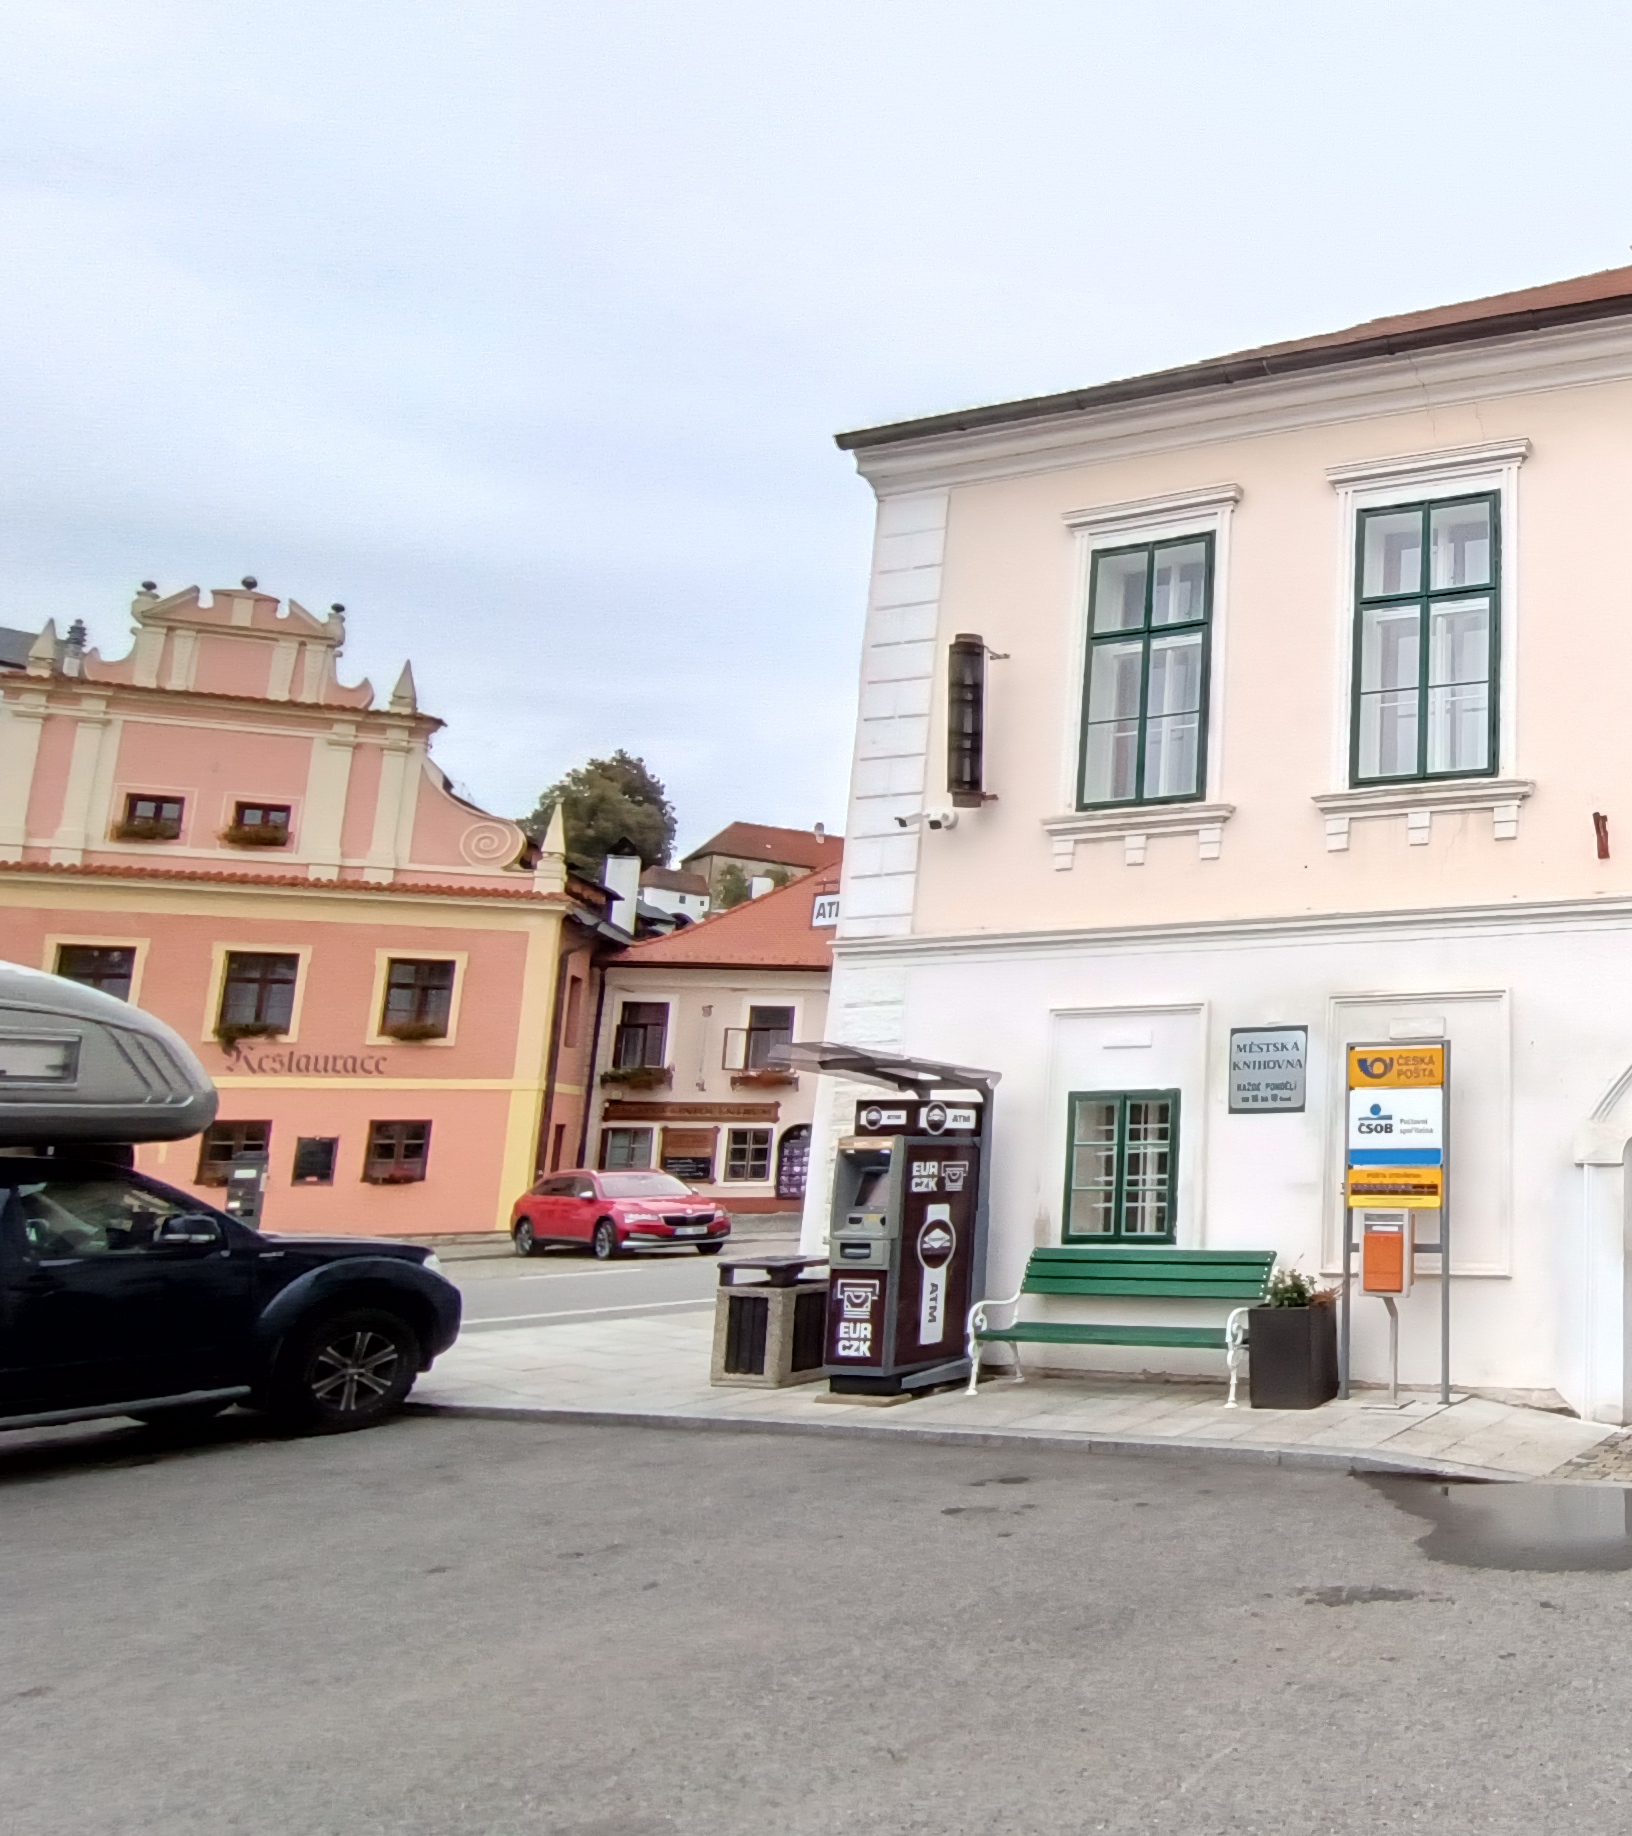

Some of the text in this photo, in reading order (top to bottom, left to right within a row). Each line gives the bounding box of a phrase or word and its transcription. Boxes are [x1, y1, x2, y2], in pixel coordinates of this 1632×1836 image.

[816, 901, 840, 919] AT
[1235, 1041, 1300, 1053] MĚSTSKÁ
[226, 1042, 387, 1075] Restaurace
[1232, 1059, 1303, 1071] KNIHOVNA
[1396, 1054, 1436, 1067] ČESKÁ
[1396, 1067, 1436, 1080] POŠTA
[952, 1114, 971, 1123] ATM
[1357, 1122, 1394, 1134] ČSOB
[912, 1161, 938, 1176] EUR
[911, 1178, 938, 1192] CZK
[927, 1282, 939, 1323] ATM
[839, 1321, 873, 1339] EUR
[837, 1340, 871, 1357] CZK
